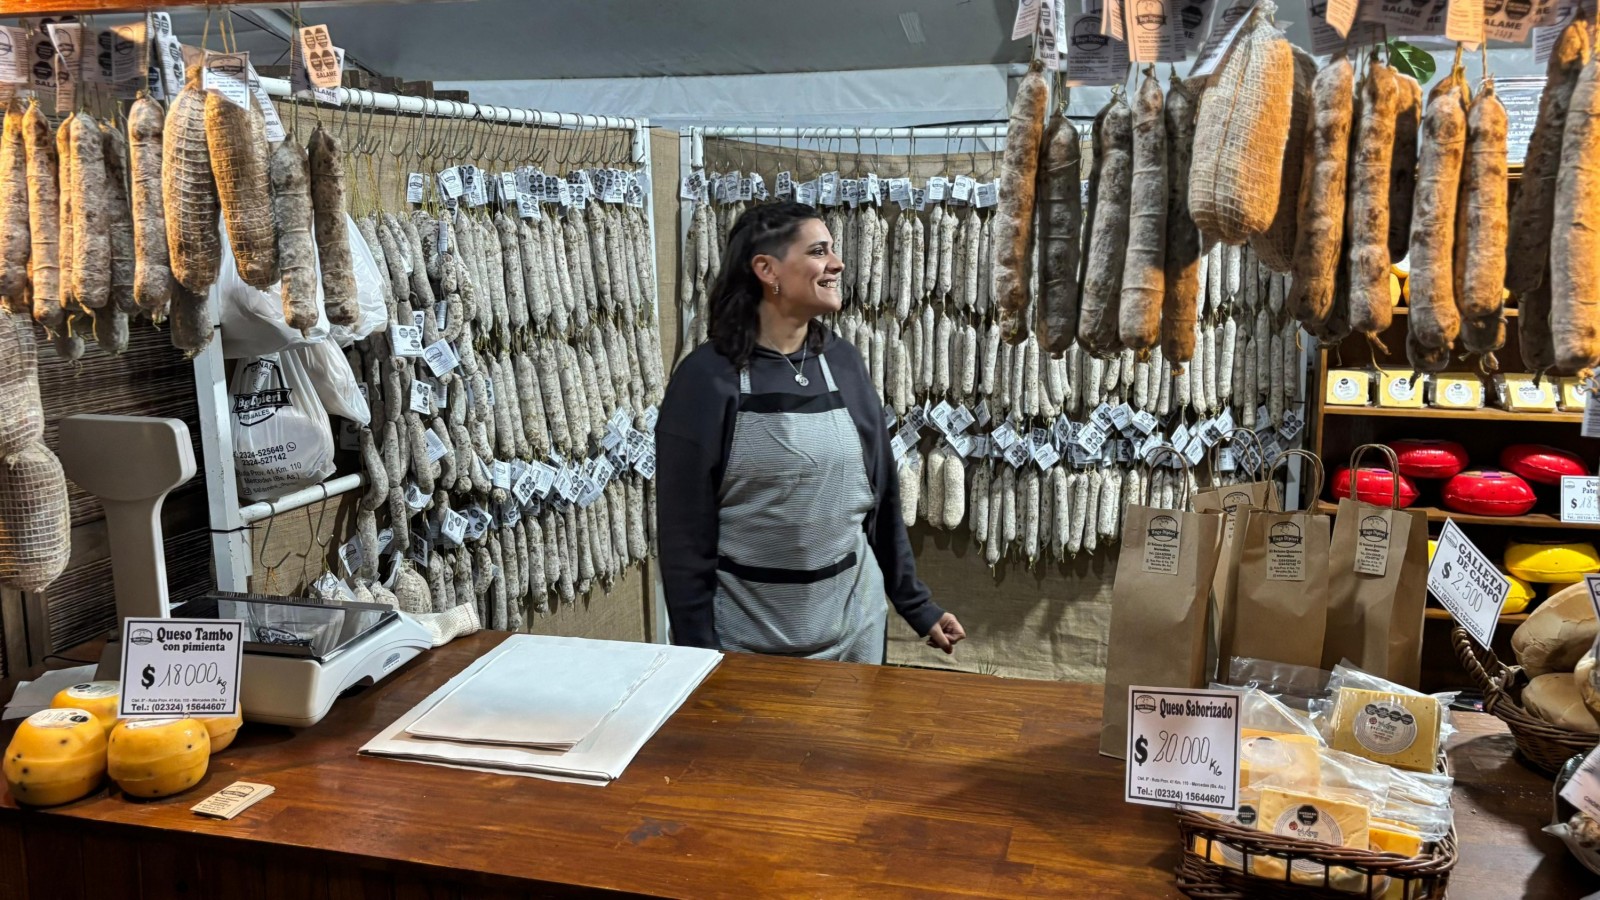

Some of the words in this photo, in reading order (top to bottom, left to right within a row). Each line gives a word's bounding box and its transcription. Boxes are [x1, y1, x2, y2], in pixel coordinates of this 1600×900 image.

[1381, 5, 1422, 18] SALAME
[1484, 18, 1522, 30] ALAME
[316, 71, 337, 79] SALAME
[34, 80, 58, 88] SALA
[240, 445, 284, 459] 2324-525649
[242, 453, 287, 466] 2324-527142
[290, 462, 302, 470] 110
[1571, 498, 1578, 509] $
[1442, 562, 1452, 580] $
[1458, 543, 1502, 596] GALLETA
[1456, 554, 1468, 572] DE
[1470, 569, 1499, 604] CAMPO
[156, 627, 192, 643] Queso
[195, 628, 234, 640] Tambo
[162, 643, 180, 651] con
[182, 642, 226, 653] pimienta
[141, 664, 156, 690] $
[152, 703, 184, 712] (02324)
[1160, 698, 1184, 718] Queso
[1186, 699, 1232, 719] Saborizado
[1134, 734, 1148, 766] $
[1136, 786, 1153, 796] Tel.:
[1155, 788, 1183, 802] (02324)
[1186, 792, 1226, 804] 15644607
